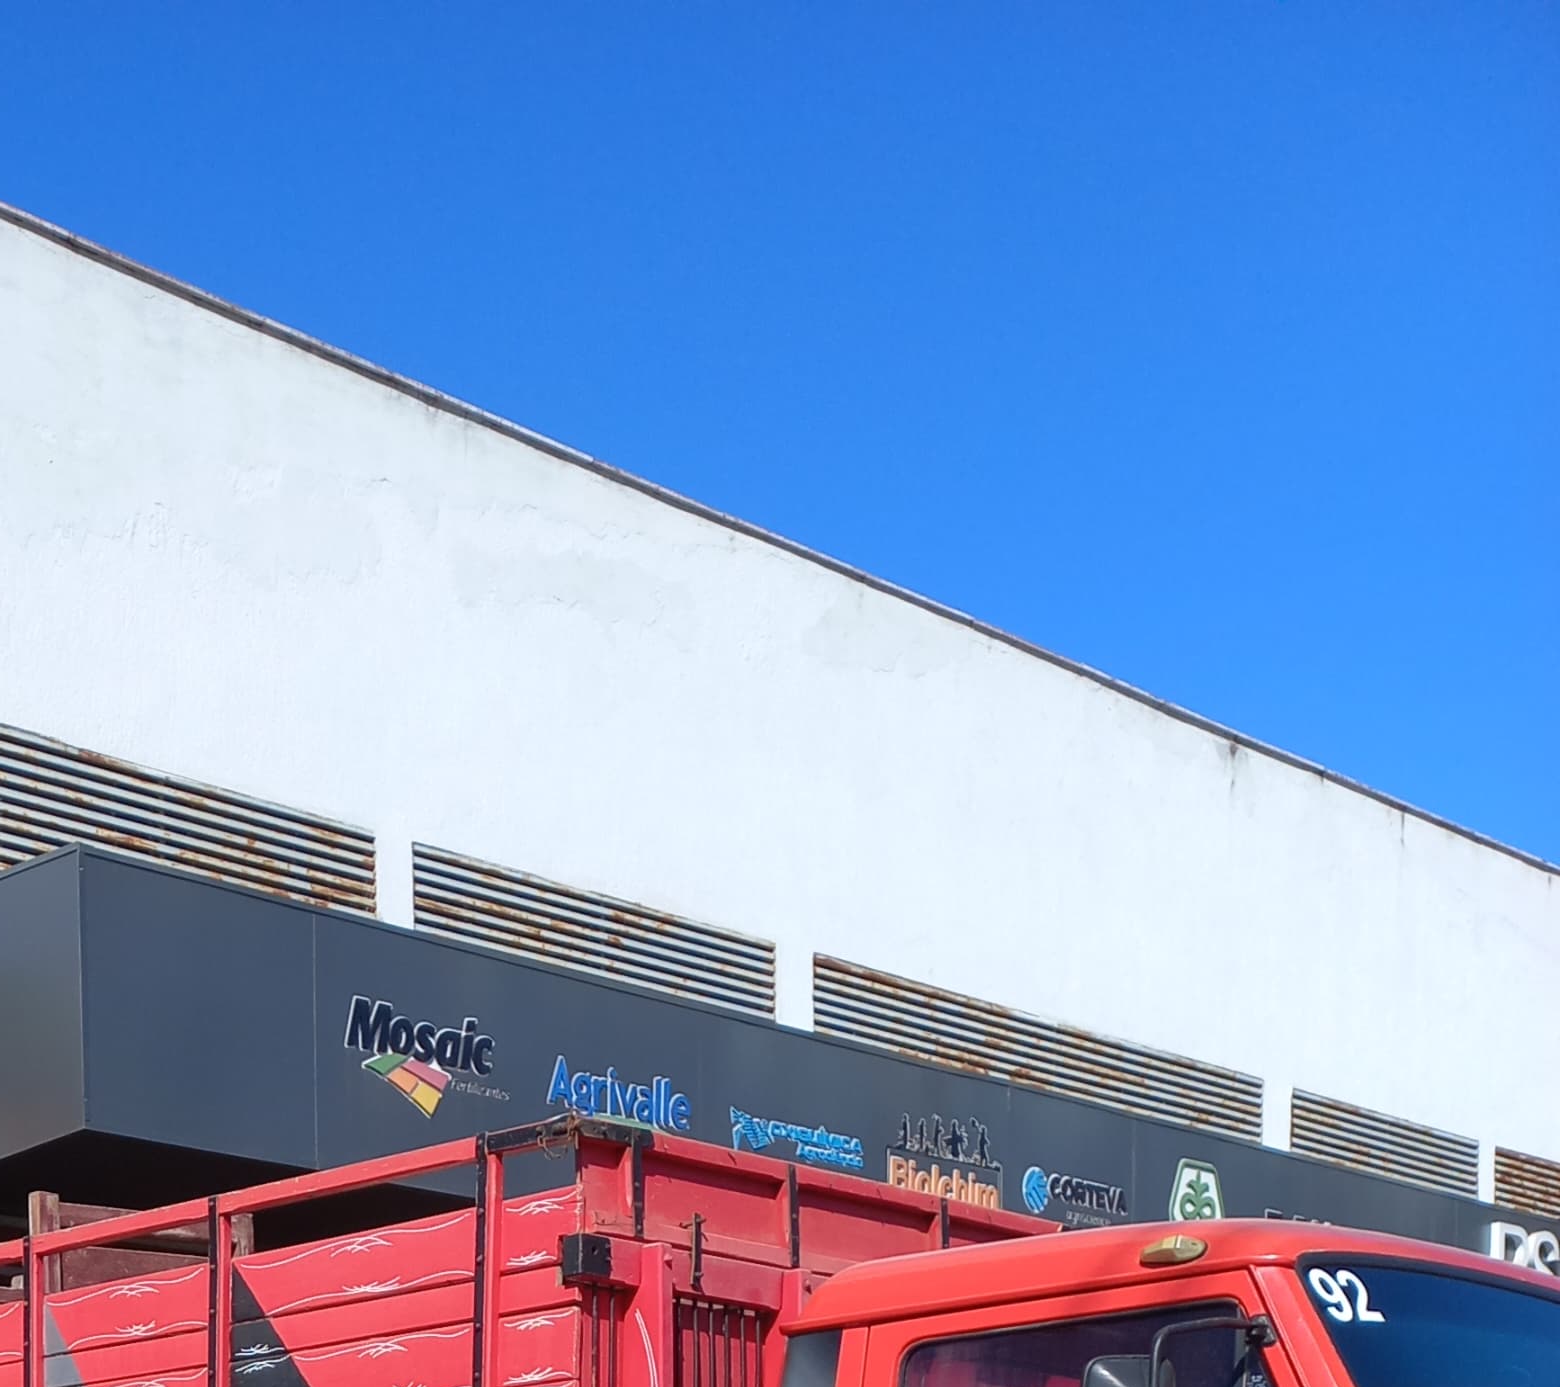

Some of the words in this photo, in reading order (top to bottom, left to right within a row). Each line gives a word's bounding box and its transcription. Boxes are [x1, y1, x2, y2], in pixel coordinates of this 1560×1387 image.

[344, 994, 496, 1077] Mosaic
[546, 1054, 691, 1131] Agrivalle
[889, 1154, 1000, 1208] Biolchim
[1047, 1172, 1129, 1217] CORTEVA
[1308, 1268, 1386, 1323] 92
